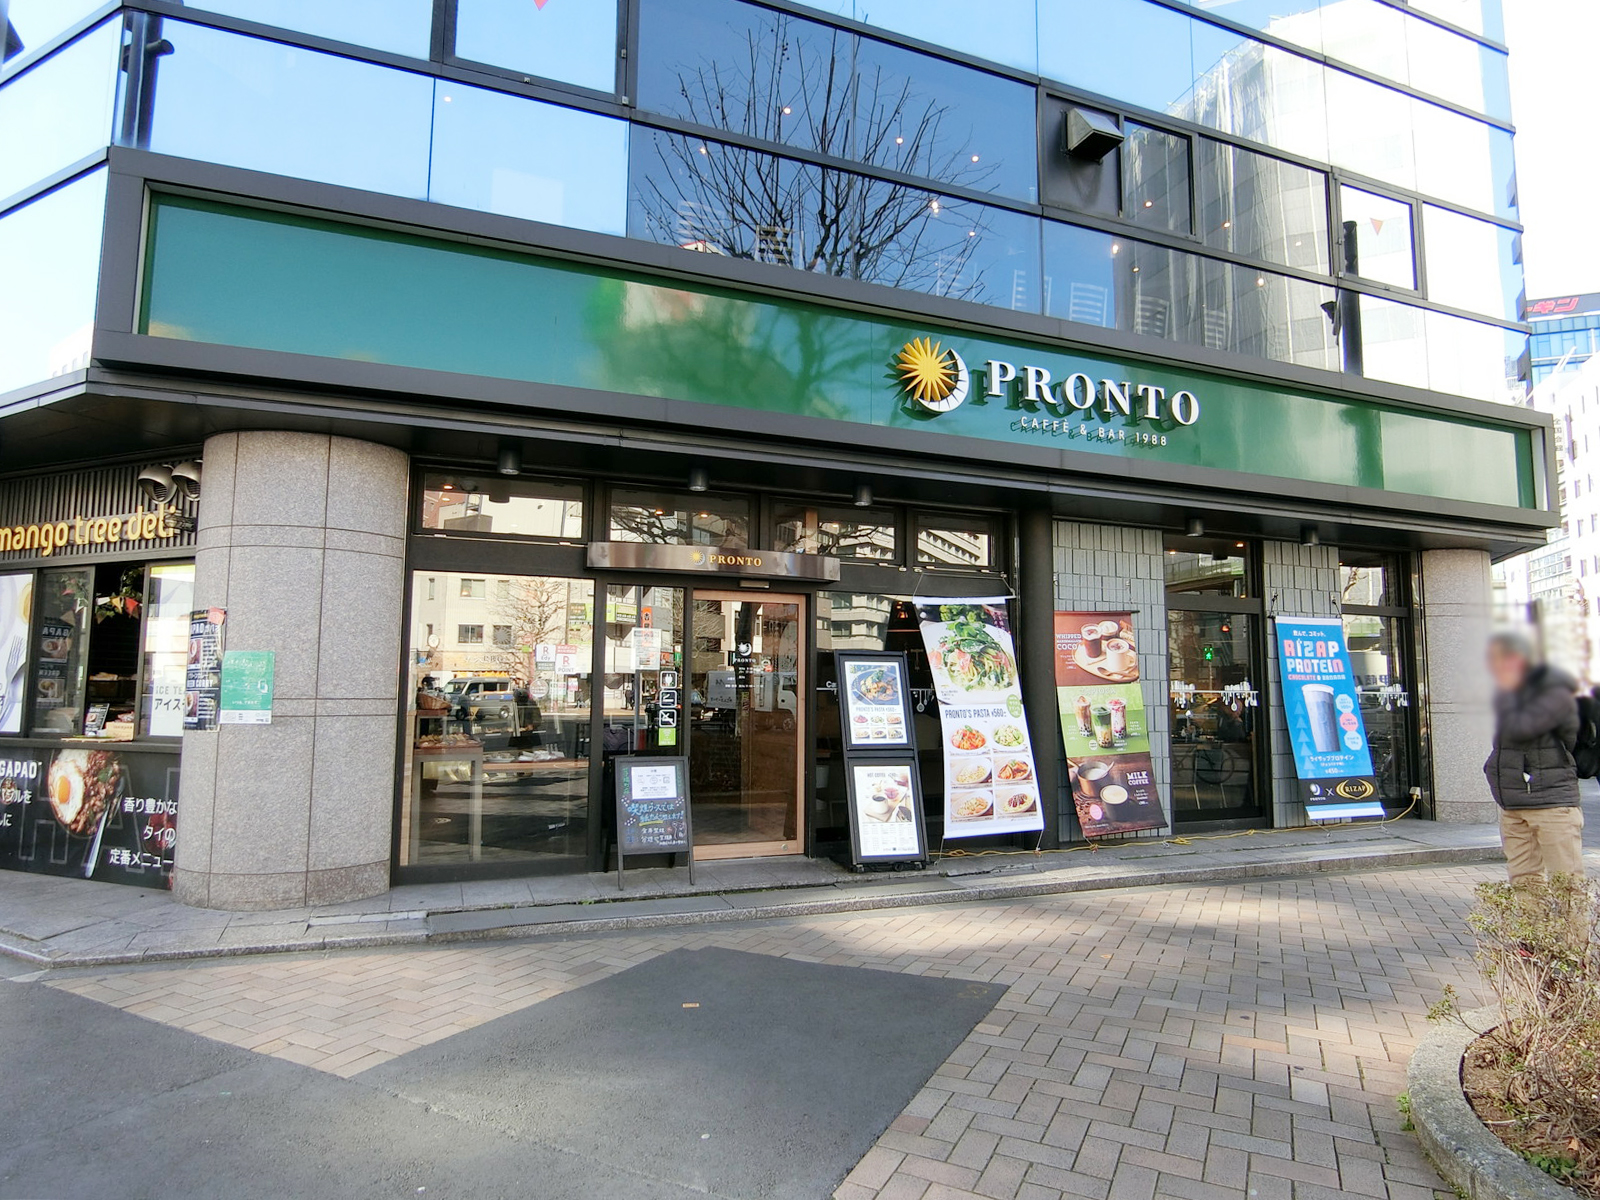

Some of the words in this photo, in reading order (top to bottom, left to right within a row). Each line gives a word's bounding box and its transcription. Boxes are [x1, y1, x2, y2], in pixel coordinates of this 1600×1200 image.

[985, 359, 1200, 427] PRONTO
[1020, 415, 1070, 434] CAFFÈ
[1080, 423, 1088, 436] &
[1099, 427, 1125, 441] BAR
[1135, 432, 1168, 447] 1988
[0, 521, 70, 557] mango
[75, 515, 123, 545] tree
[128, 503, 177, 541] deli
[709, 554, 762, 567] PRONTO
[543, 646, 549, 655] R
[563, 656, 569, 665] R
[1286, 658, 1345, 674] PROTEIN
[156, 686, 169, 695] ICE
[173, 686, 185, 695] TE
[155, 698, 185, 711] アイス
[944, 709, 973, 720] PRONTO'S
[973, 709, 990, 719] PASTA
[1126, 771, 1148, 780] MILK
[1127, 779, 1150, 787] COFFEE
[1345, 785, 1366, 793] RIZAP
[124, 797, 178, 815] 香り豊かな
[143, 825, 176, 842] タイの
[109, 848, 174, 868] 定番メニュー
